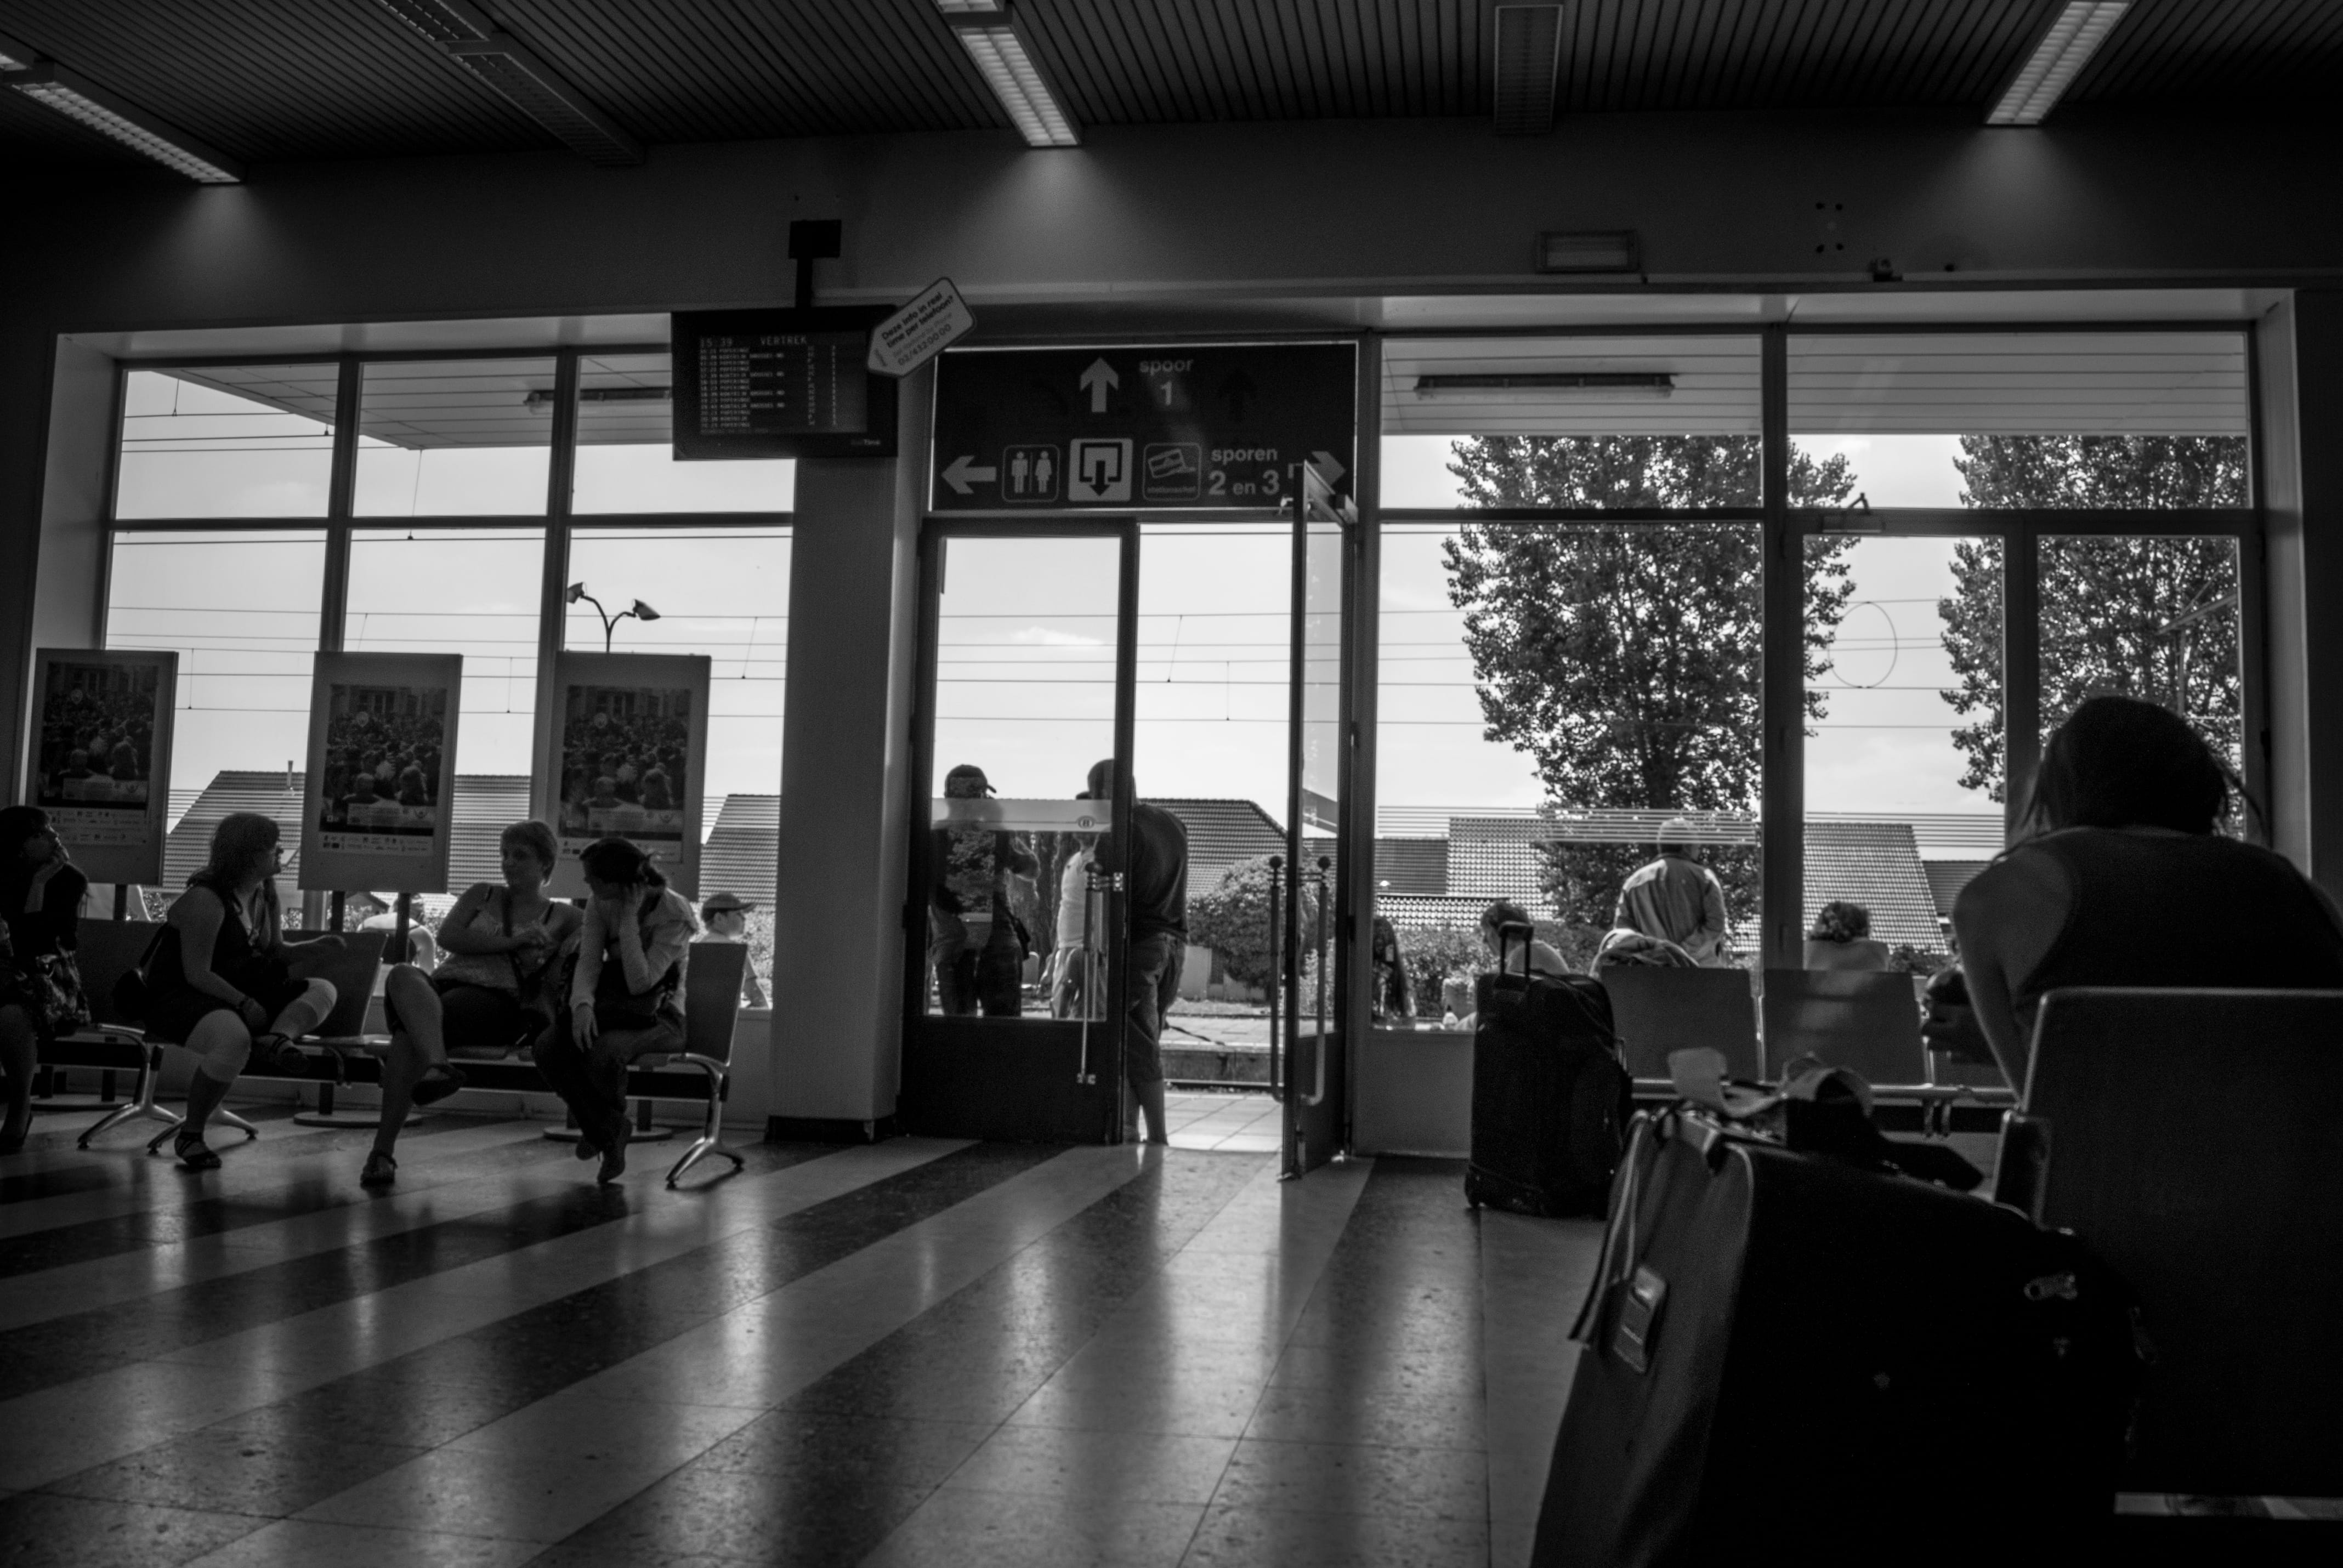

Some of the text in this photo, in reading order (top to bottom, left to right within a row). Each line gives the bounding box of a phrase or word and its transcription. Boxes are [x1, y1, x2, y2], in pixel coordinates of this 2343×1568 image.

[882, 325, 901, 339] Deze
[902, 311, 918, 325] info
[918, 305, 927, 313] in
[927, 291, 942, 307] real
[887, 333, 904, 347] time
[905, 322, 918, 336] per
[919, 295, 952, 324] telefoon?
[1139, 359, 1194, 377] spoor
[1161, 380, 1172, 405] 1
[1211, 448, 1278, 465] sporen
[1209, 469, 1280, 495] 2 en 3
